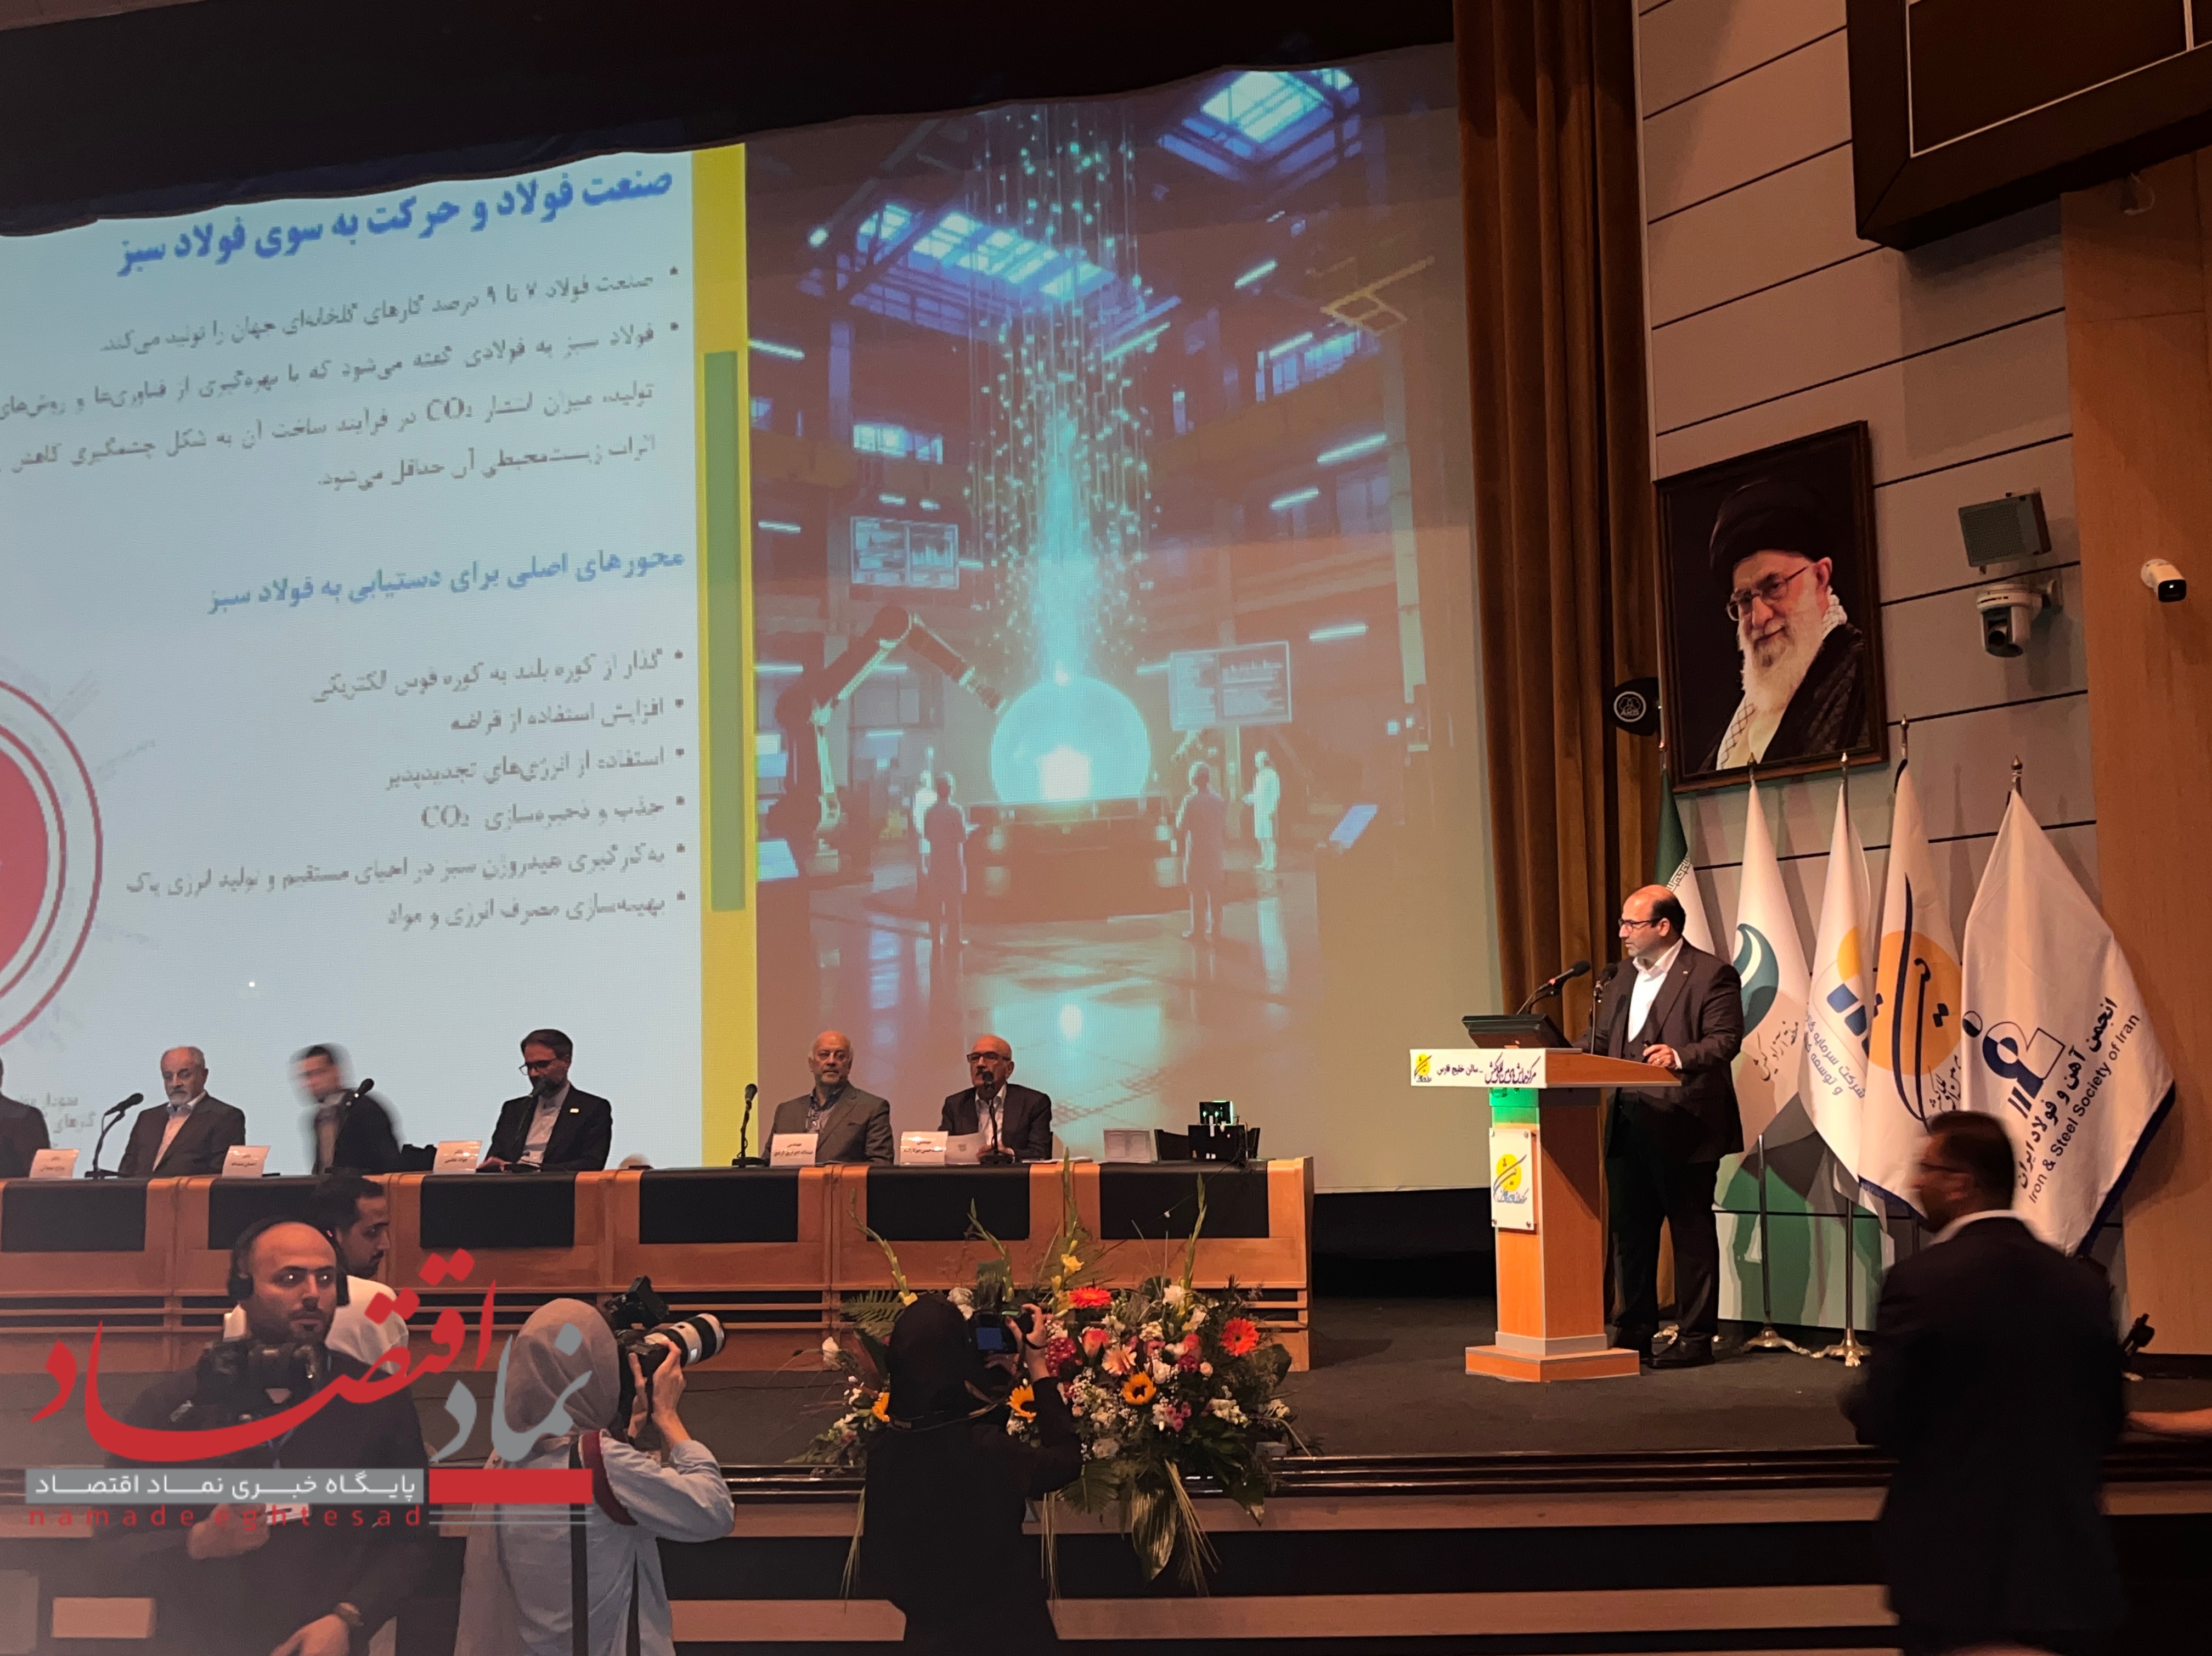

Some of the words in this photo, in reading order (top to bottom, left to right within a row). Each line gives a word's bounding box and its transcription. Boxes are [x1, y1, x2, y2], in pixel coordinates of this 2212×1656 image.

[497, 172, 574, 223] فولاد
[582, 168, 672, 207] صنعت
[331, 212, 359, 245] به
[367, 196, 461, 239] حرکت
[470, 198, 488, 232] و
[173, 216, 247, 265] فولاد
[255, 223, 324, 260] سوی
[116, 240, 166, 278] سبز
[546, 275, 589, 303] فولاد
[610, 322, 654, 349] فولاد
[450, 560, 499, 594] برای
[507, 551, 569, 589] اصلی
[574, 549, 685, 582] محورهای
[207, 589, 251, 616] سبز
[258, 576, 314, 608] فولاد
[321, 579, 343, 604] به
[348, 568, 442, 605] دستیابی
[2089, 996, 2118, 1053] انجمن
[1813, 1032, 1839, 1066] سرمایه
[1437, 1063, 1451, 1077] فارس
[1451, 1064, 1465, 1076] خلیج
[1465, 1063, 1479, 1077] سالن
[1810, 1052, 1838, 1086] توسعه
[1838, 1066, 1866, 1099] شرکت
[2063, 1044, 2086, 1090] آهن
[1831, 1086, 1844, 1096] و
[2056, 1090, 2070, 1106] و
[2028, 1175, 2048, 1204] Iron
[2042, 1158, 2056, 1172] &
[2050, 1117, 2079, 1157] Steel
[2072, 1062, 2113, 1118] Society
[2108, 1043, 2121, 1061] of
[2115, 1013, 2141, 1045] Iran
[2031, 1099, 2059, 1143] فولاد
[2018, 1140, 2036, 1190] ایران
